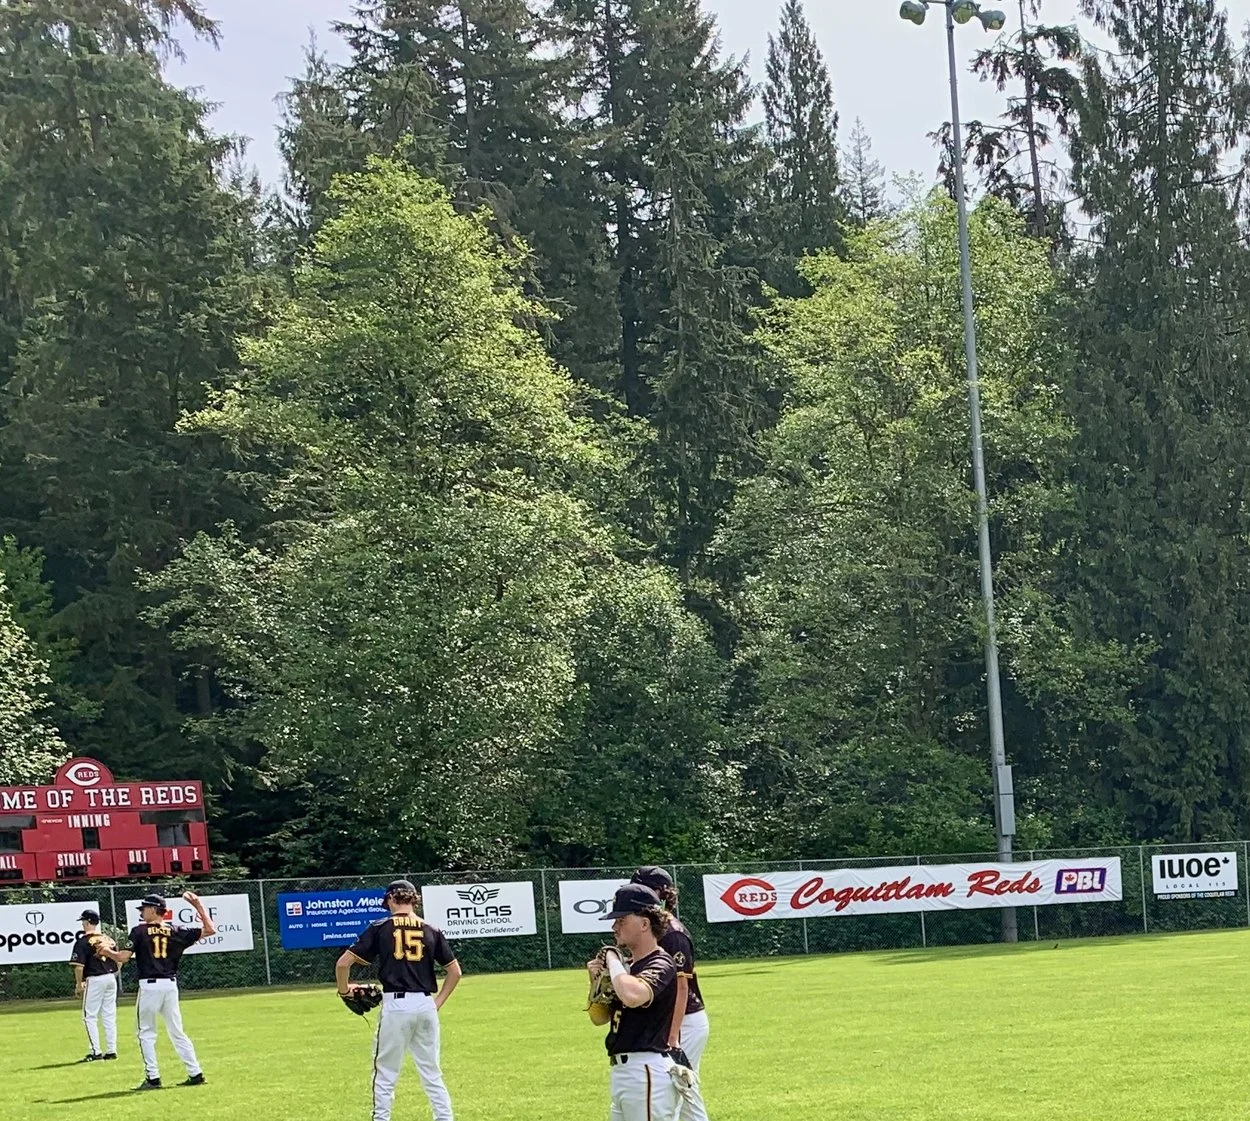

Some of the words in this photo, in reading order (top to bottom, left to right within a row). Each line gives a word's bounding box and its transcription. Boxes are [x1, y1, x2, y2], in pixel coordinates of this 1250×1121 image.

[1, 790, 37, 810] ME
[46, 789, 73, 808] OF
[84, 787, 131, 807] THE
[140, 786, 197, 805] REDS
[67, 814, 111, 828] INNING
[57, 852, 92, 867] STRIKE
[128, 850, 147, 863] OUT
[193, 848, 199, 860] E
[1060, 870, 1102, 892] PBL
[738, 892, 778, 903] REDS
[790, 876, 955, 912] Coquitlam
[966, 869, 1043, 898] Reds
[305, 898, 353, 910] Johnston
[356, 897, 384, 907] Meie
[306, 908, 338, 916] Insurance
[338, 907, 368, 916] Agencies
[446, 905, 512, 919] ATLAS
[393, 916, 422, 928] GRANT
[152, 936, 168, 959] 11
[393, 929, 425, 961] 15
